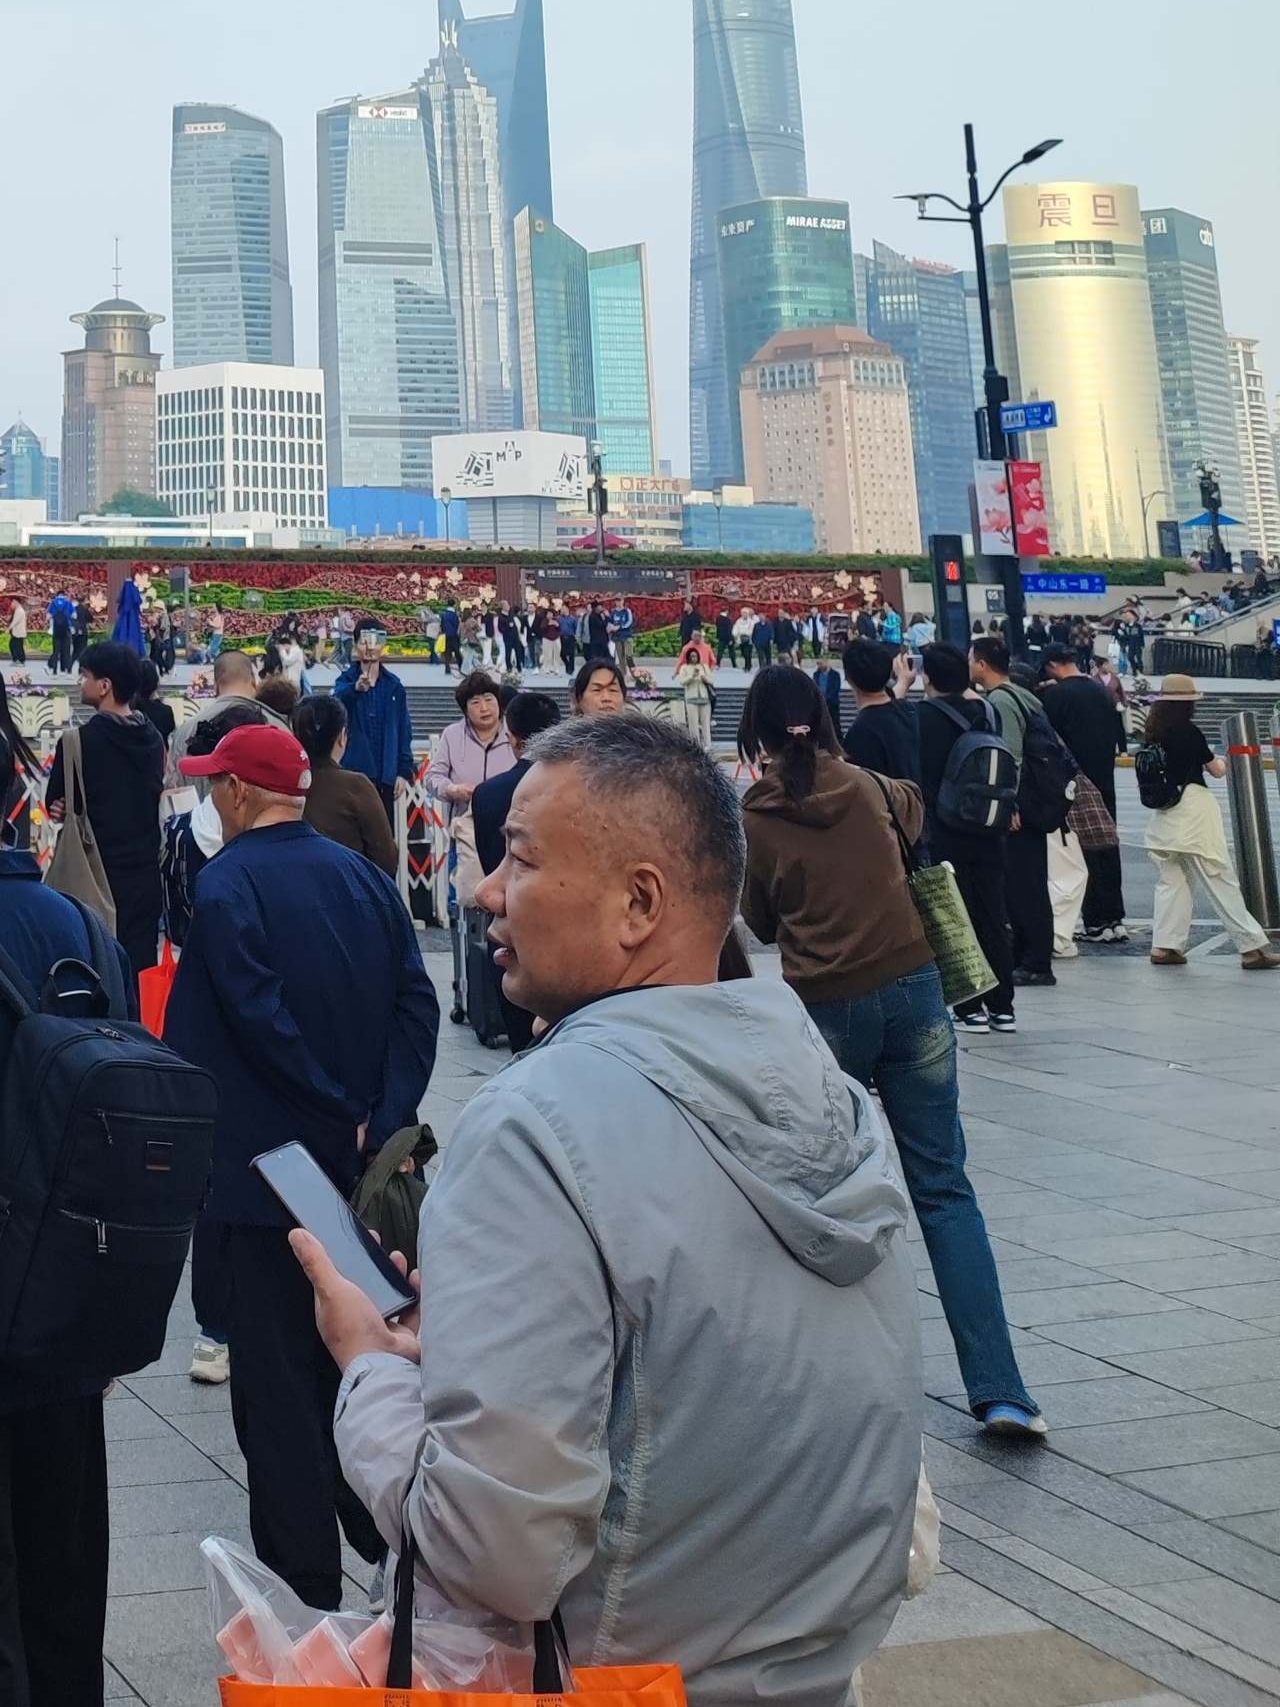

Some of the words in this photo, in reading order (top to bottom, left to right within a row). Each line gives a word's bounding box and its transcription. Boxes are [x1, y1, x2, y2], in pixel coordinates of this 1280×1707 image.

[1038, 193, 1120, 227] 震旦
[786, 215, 819, 229] MIRAE
[820, 218, 846, 230] ASSET
[496, 440, 522, 462] MAP
[1037, 578, 1090, 590] 中山东一路
